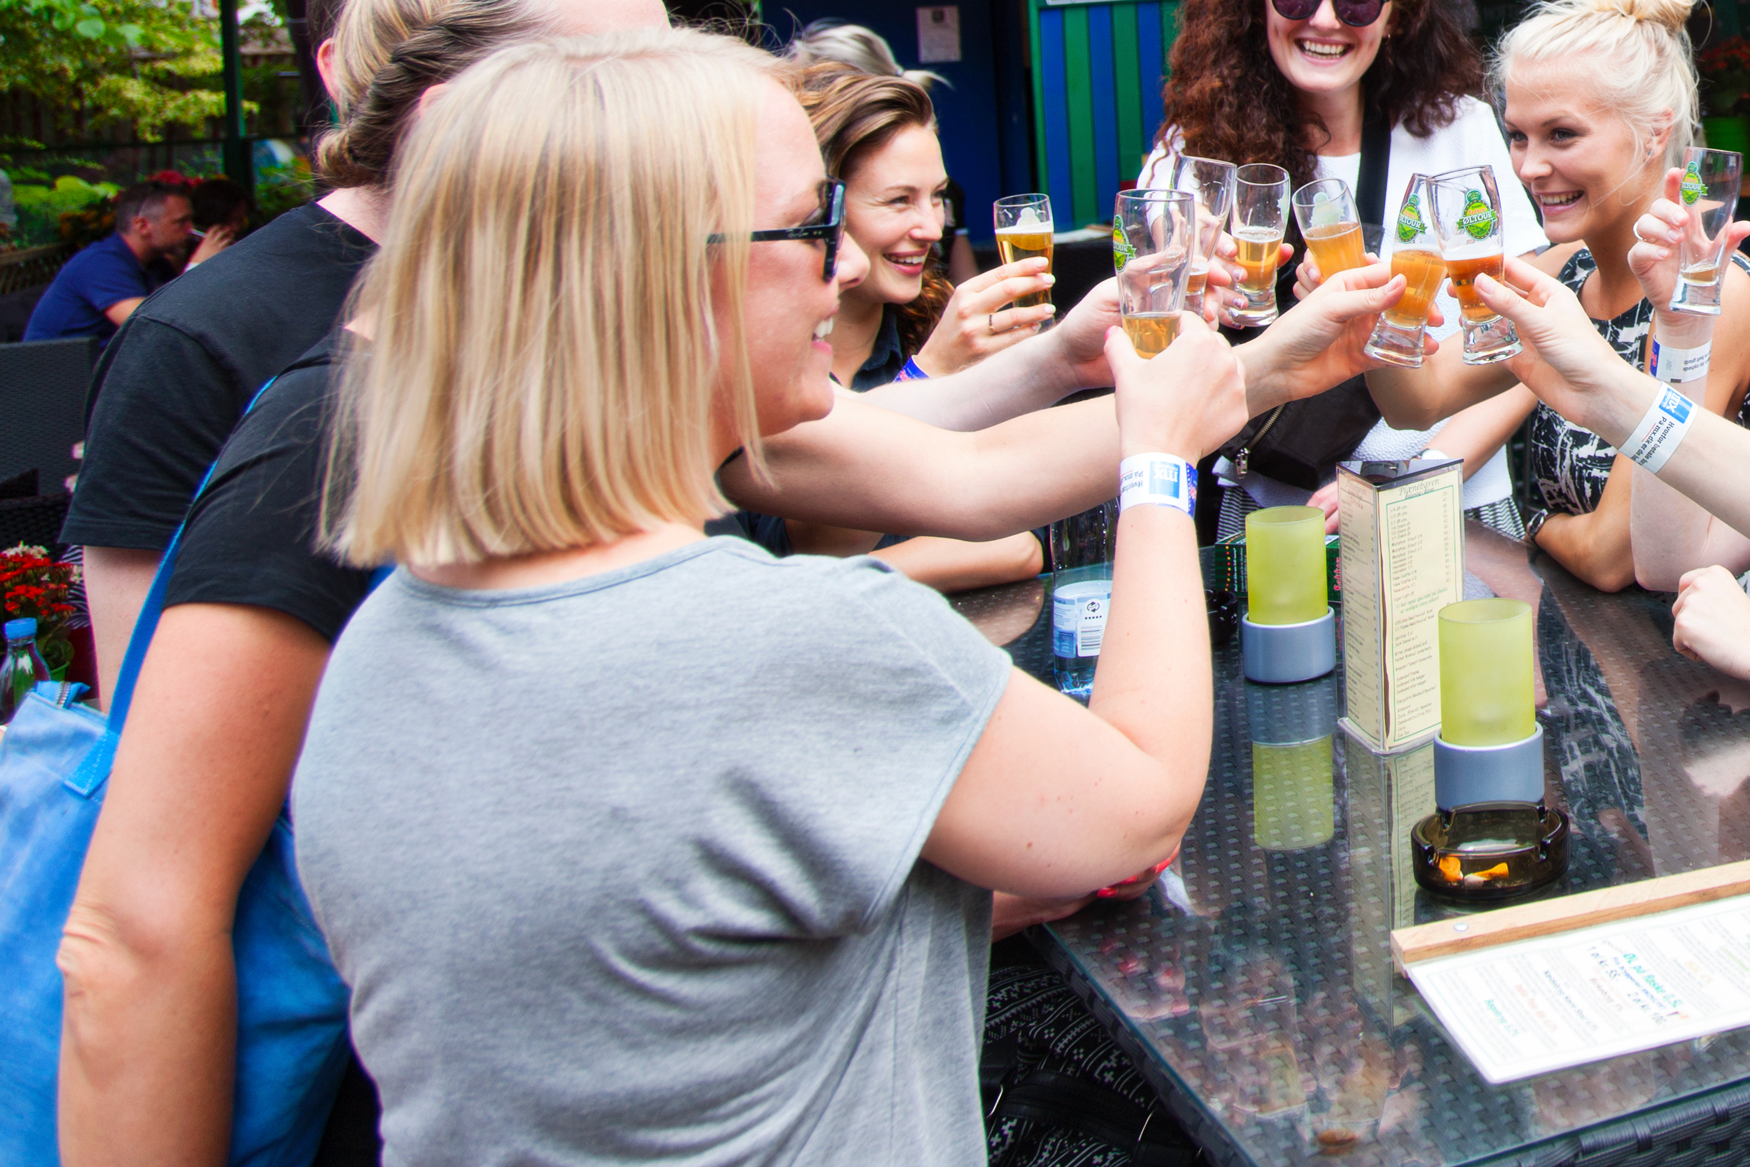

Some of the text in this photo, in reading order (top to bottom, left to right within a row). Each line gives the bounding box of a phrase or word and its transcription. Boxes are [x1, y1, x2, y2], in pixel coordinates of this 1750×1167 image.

[1657, 415, 1667, 426] På
[1655, 421, 1675, 444] Hvorfor
[1644, 442, 1659, 460] betale
